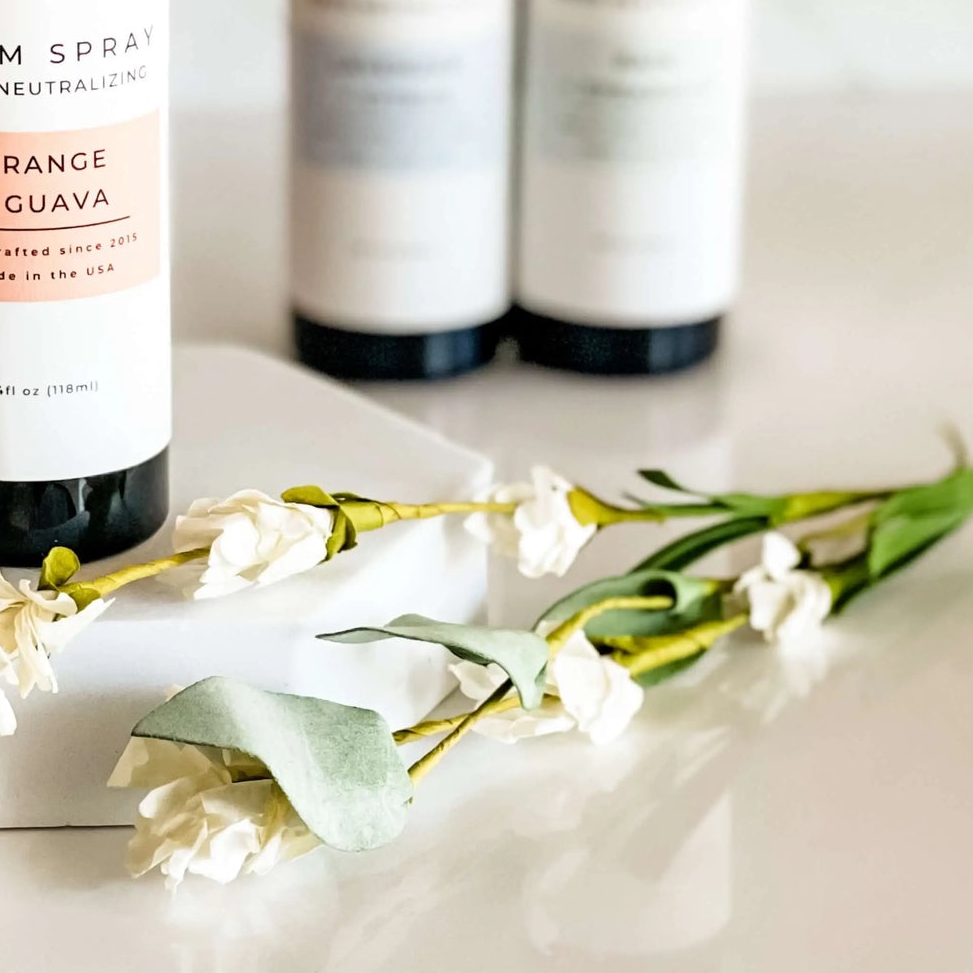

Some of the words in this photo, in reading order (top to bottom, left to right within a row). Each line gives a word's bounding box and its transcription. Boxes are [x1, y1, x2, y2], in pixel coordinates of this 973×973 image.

[49, 24, 154, 64] SPRAY
[4, 188, 109, 213] GUAVA
[59, 241, 102, 255] since
[109, 232, 138, 248] 2015
[25, 270, 41, 281] in
[50, 269, 77, 280] the
[86, 263, 115, 276] USA
[22, 386, 40, 397] oz
[46, 380, 99, 398] (118ml)
